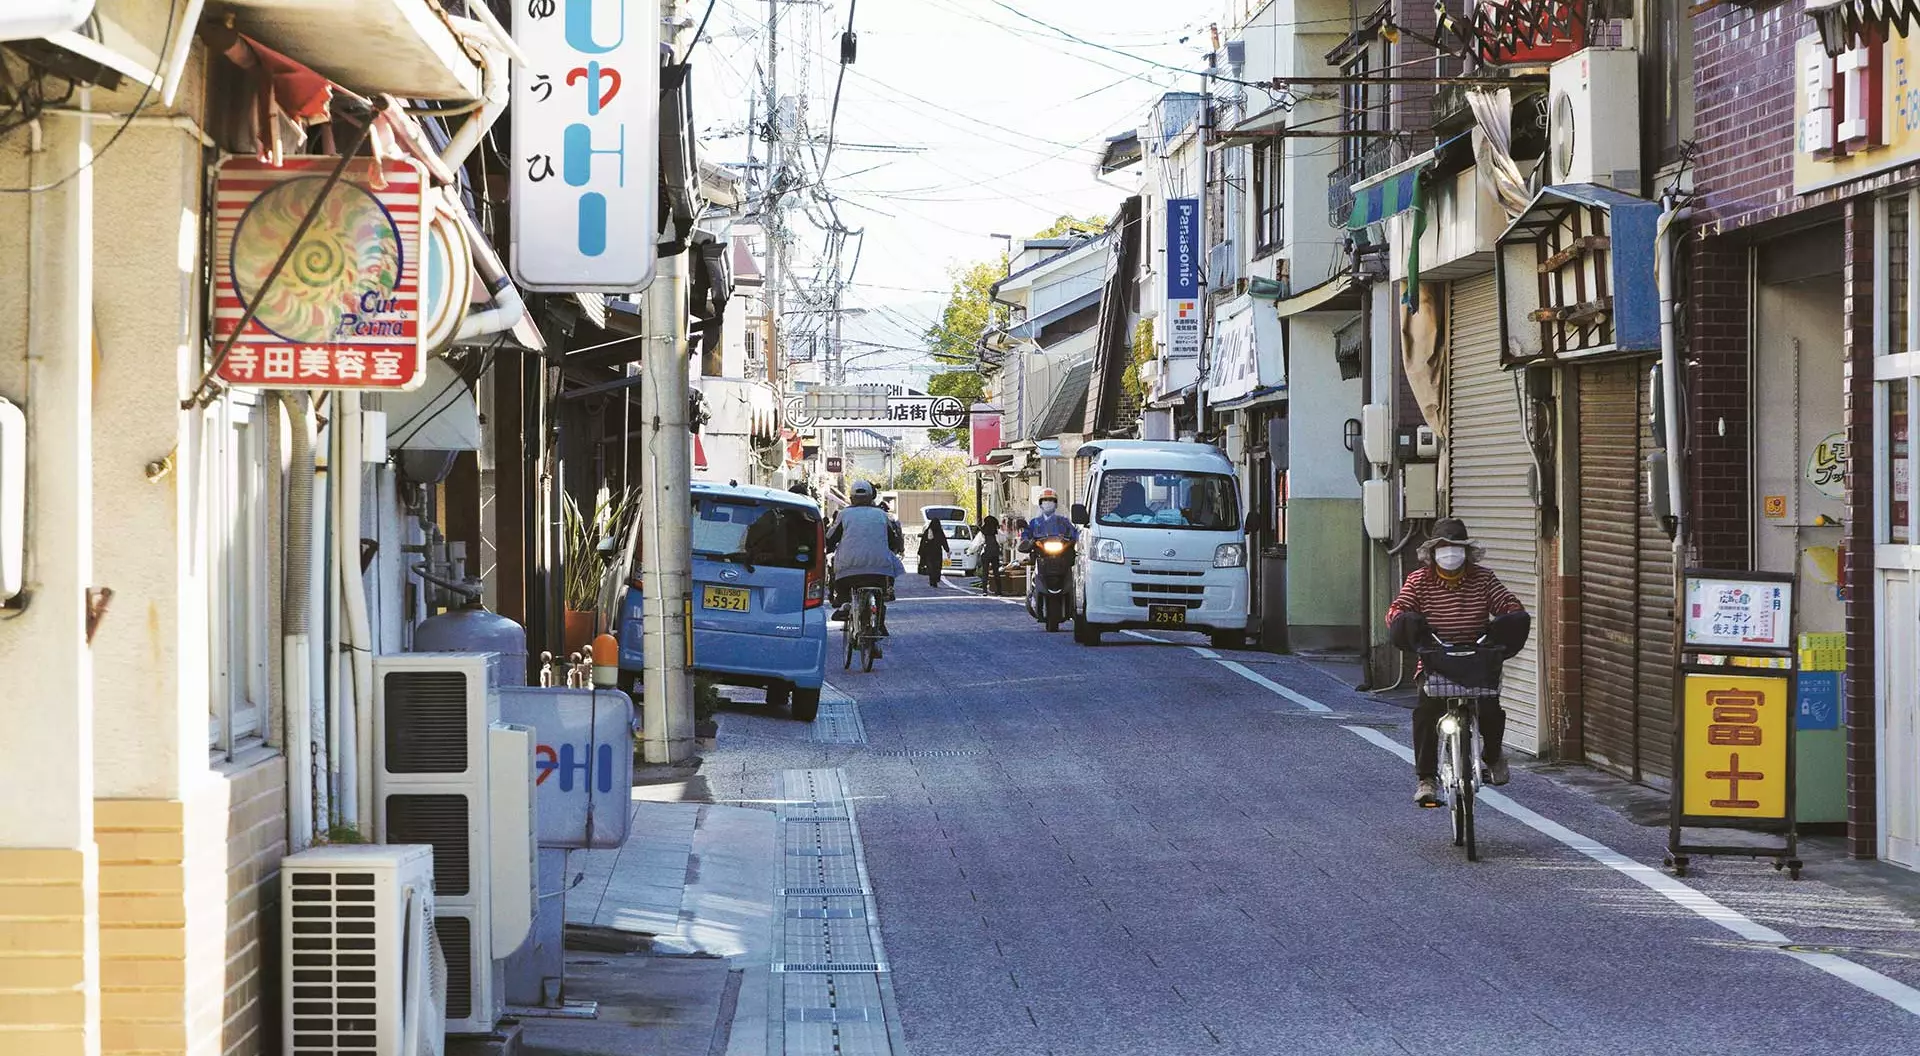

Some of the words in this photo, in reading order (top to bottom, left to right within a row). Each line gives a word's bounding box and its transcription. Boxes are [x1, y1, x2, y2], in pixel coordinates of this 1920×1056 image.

[1179, 204, 1193, 288] Panasonic
[360, 291, 398, 314] Cut
[336, 313, 403, 336] Perma
[228, 346, 403, 381] 寺田美容室
[712, 595, 747, 611] 59-21
[1713, 611, 1752, 624] クーポン
[1705, 687, 1765, 809] 富士
